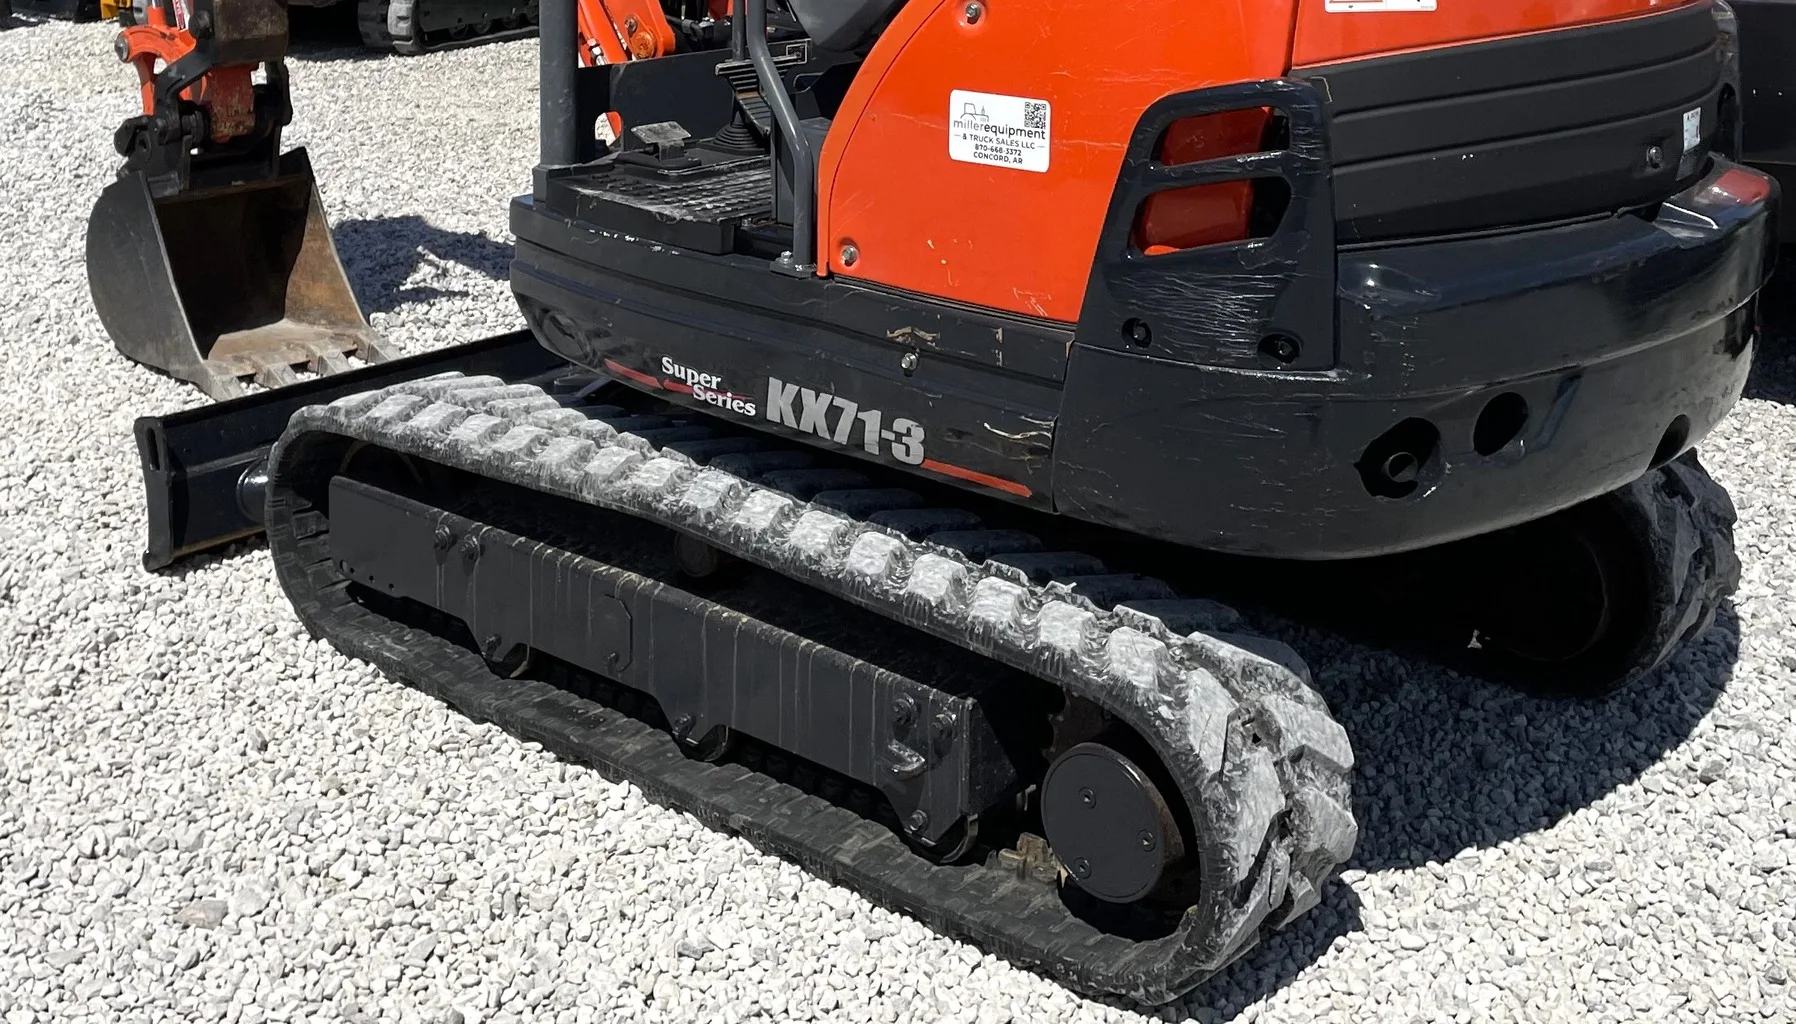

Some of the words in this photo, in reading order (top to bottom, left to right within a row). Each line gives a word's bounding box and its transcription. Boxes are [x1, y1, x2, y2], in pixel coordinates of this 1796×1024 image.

[953, 119, 1046, 140] millerequipment
[969, 133, 994, 144] TRUCK
[995, 137, 1020, 148] SALES
[1021, 141, 1036, 150] LLC
[1012, 156, 1023, 165] AR
[661, 356, 721, 391] Super
[692, 383, 756, 417] Series
[766, 376, 926, 466] KX71-3
